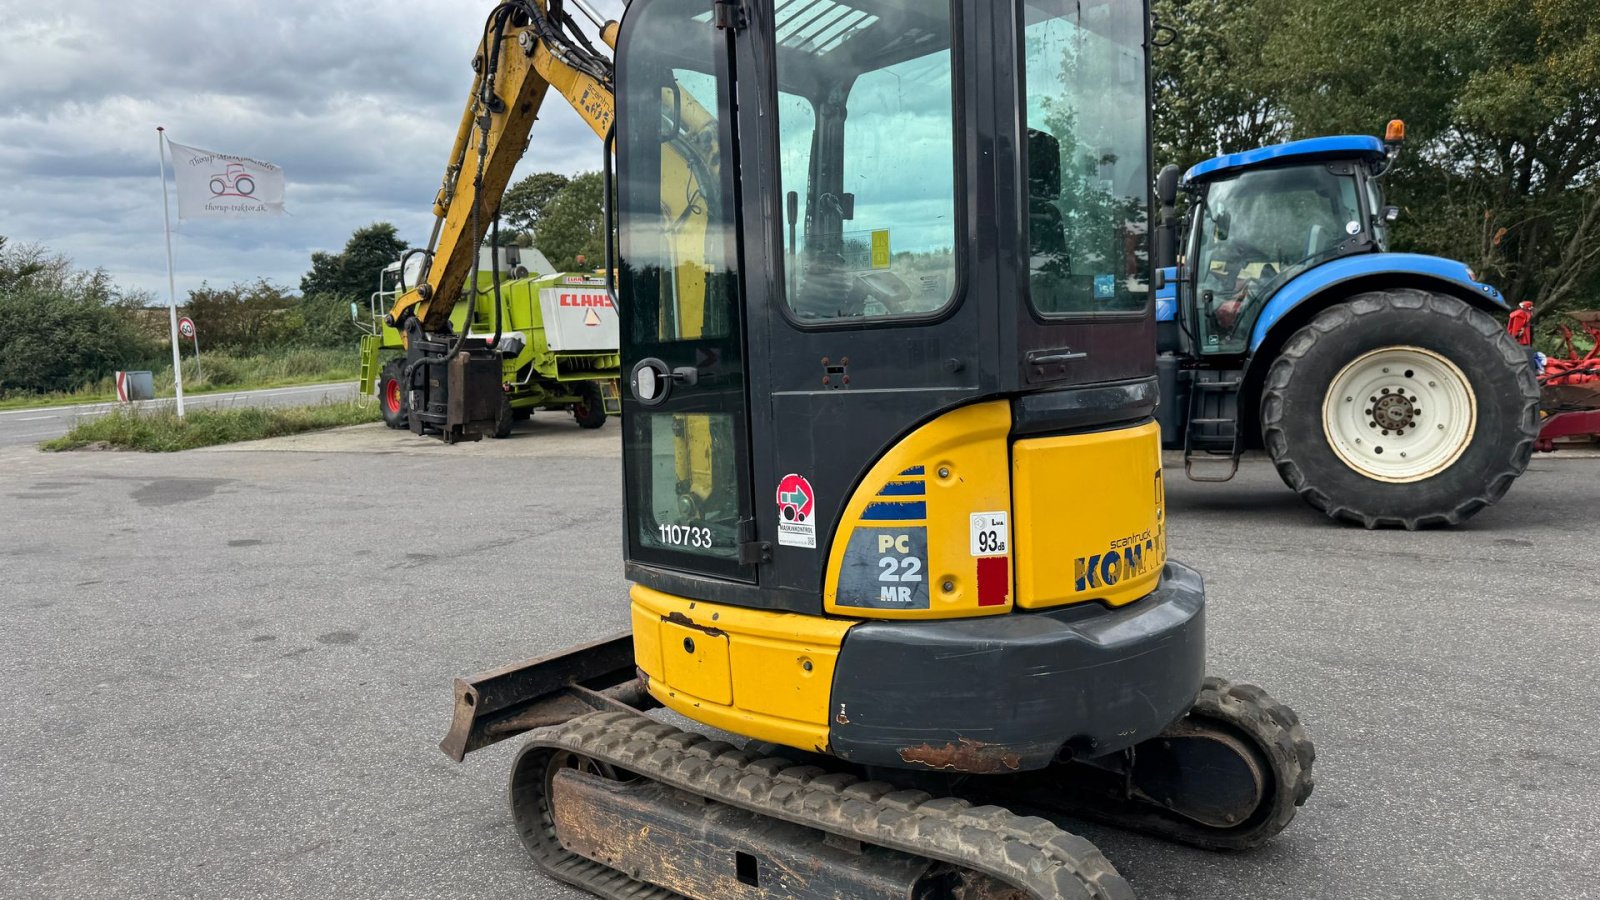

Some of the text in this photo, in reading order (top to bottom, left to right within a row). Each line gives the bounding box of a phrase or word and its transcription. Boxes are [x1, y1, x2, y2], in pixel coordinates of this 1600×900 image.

[205, 202, 267, 212] thorup-traktor.dk
[560, 294, 613, 307] CLAAS
[658, 523, 712, 549] 110733
[878, 534, 909, 553] PC
[979, 530, 998, 552] 93
[1110, 527, 1151, 550] scantruck
[878, 556, 922, 582] 22
[880, 586, 912, 602] MR
